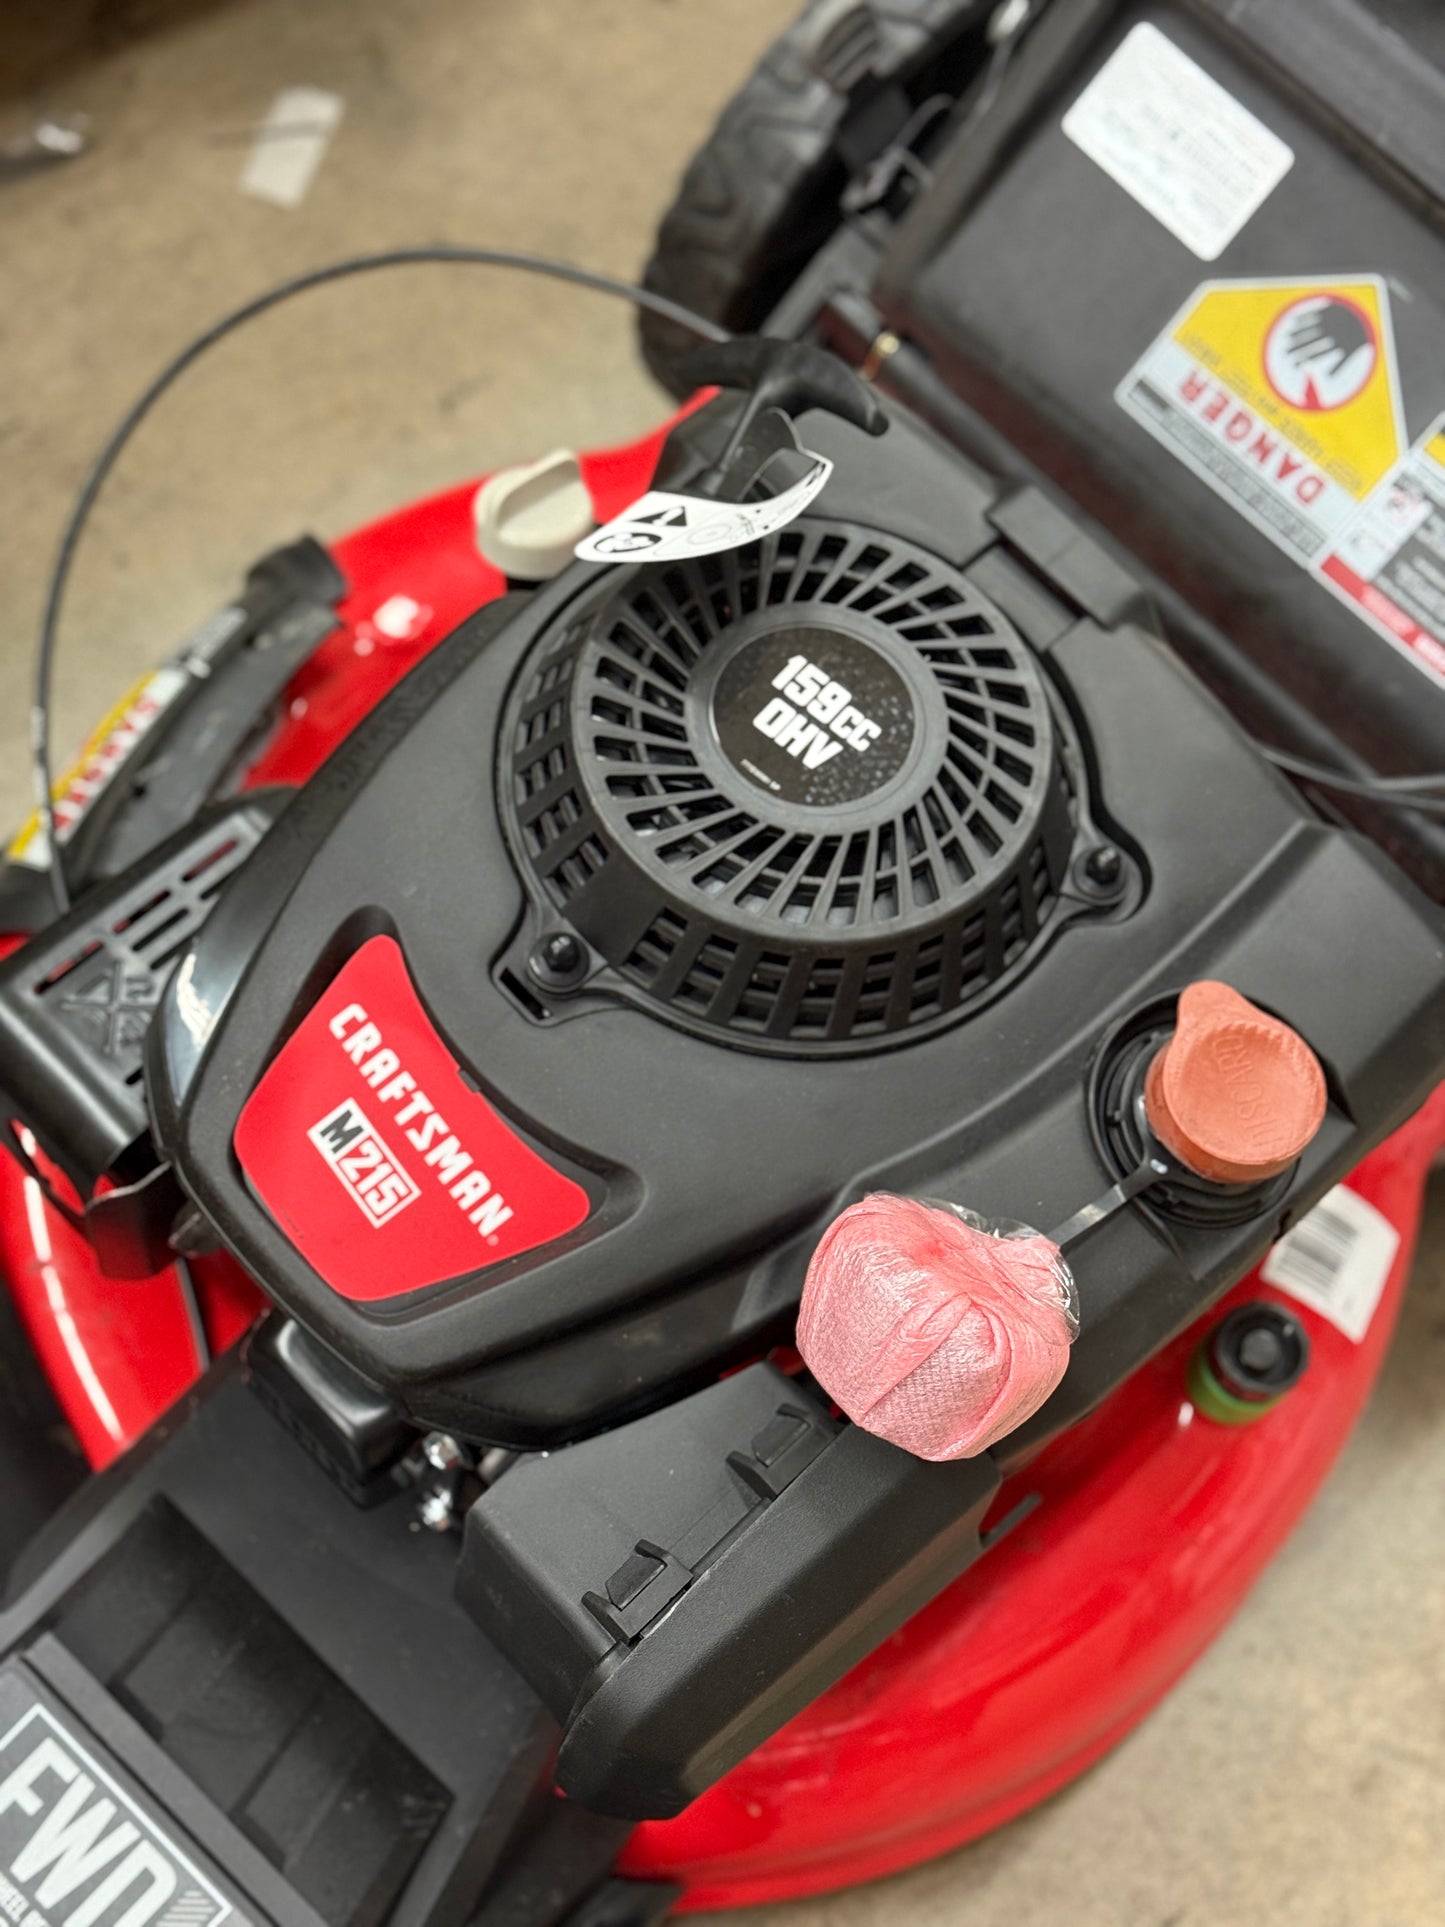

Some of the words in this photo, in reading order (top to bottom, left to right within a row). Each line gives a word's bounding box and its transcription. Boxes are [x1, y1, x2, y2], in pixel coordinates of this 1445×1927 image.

[1180, 371, 1325, 505] DANGER
[752, 697, 844, 770] OHV
[771, 654, 882, 752] 159cc
[328, 1003, 514, 1238] CRAFTSMAN
[1211, 1034, 1287, 1149] DISCARD
[319, 1109, 411, 1217] M215
[0, 1736, 177, 1927] FWD
